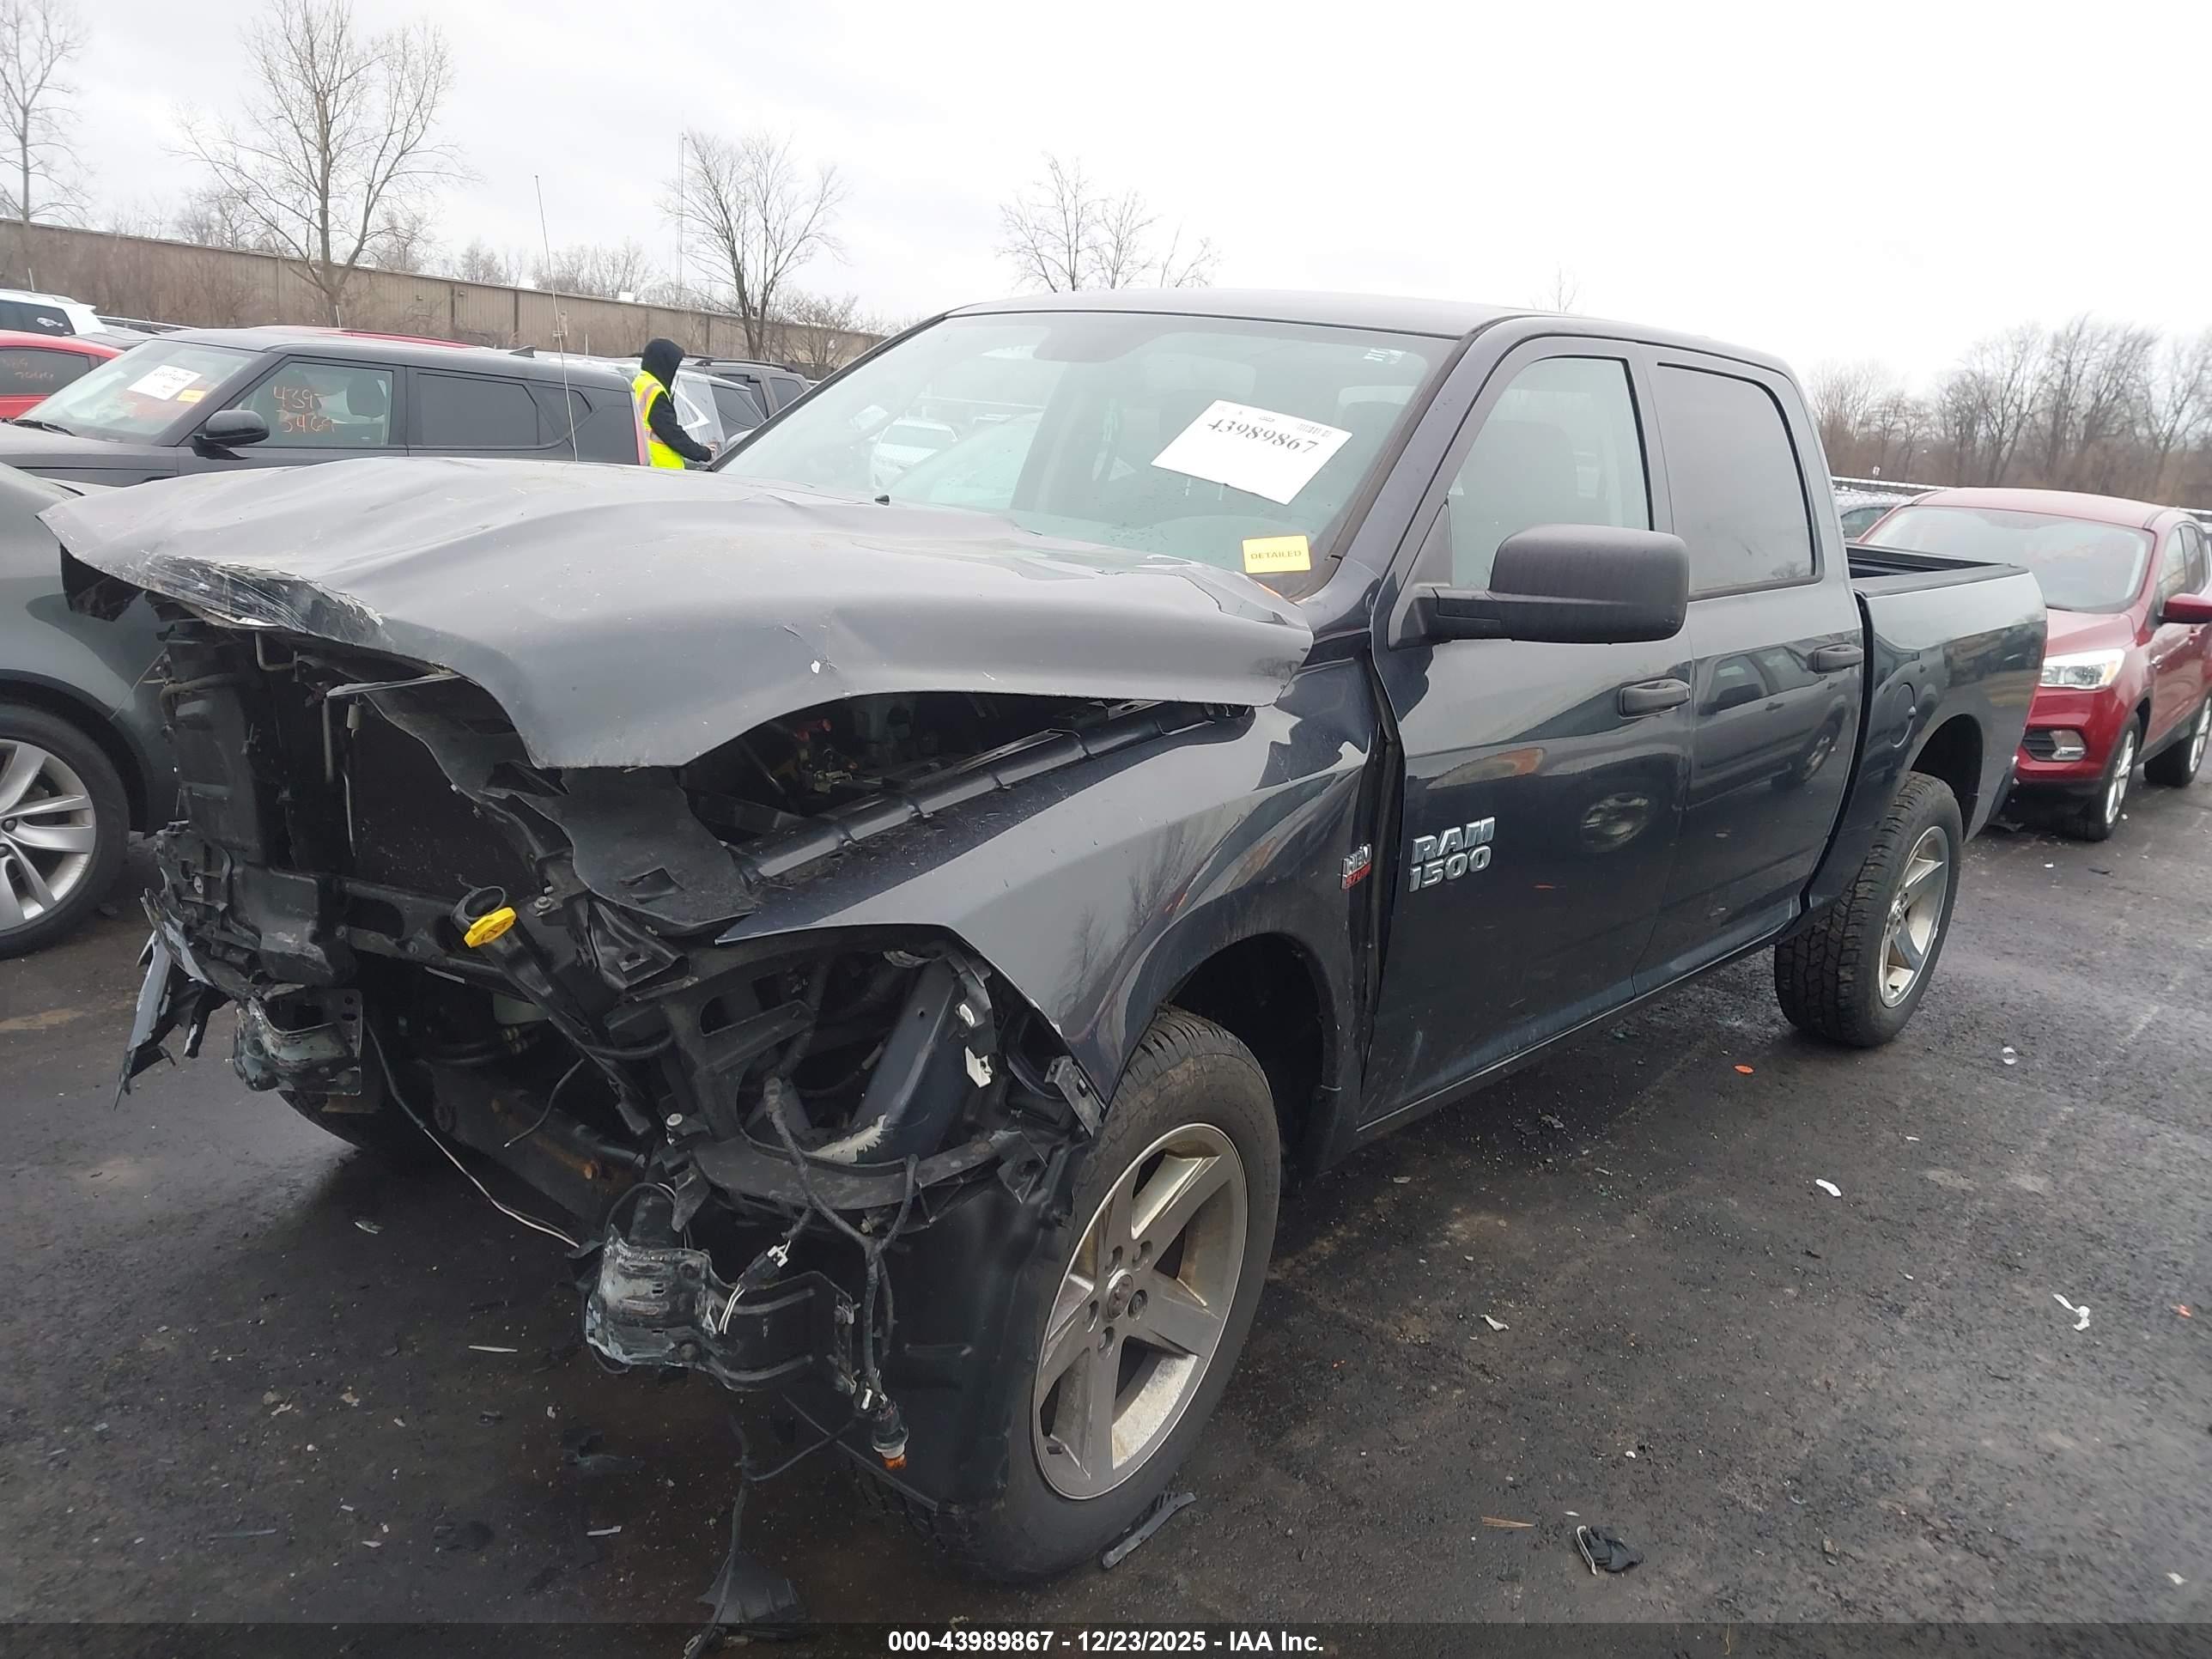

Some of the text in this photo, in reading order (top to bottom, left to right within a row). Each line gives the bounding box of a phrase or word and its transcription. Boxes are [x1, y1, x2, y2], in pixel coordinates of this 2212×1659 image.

[1207, 419, 1319, 453] 43989867
[1251, 550, 1302, 560] DETAILED
[1411, 817, 1496, 864] RAM
[1409, 846, 1492, 893] 1500
